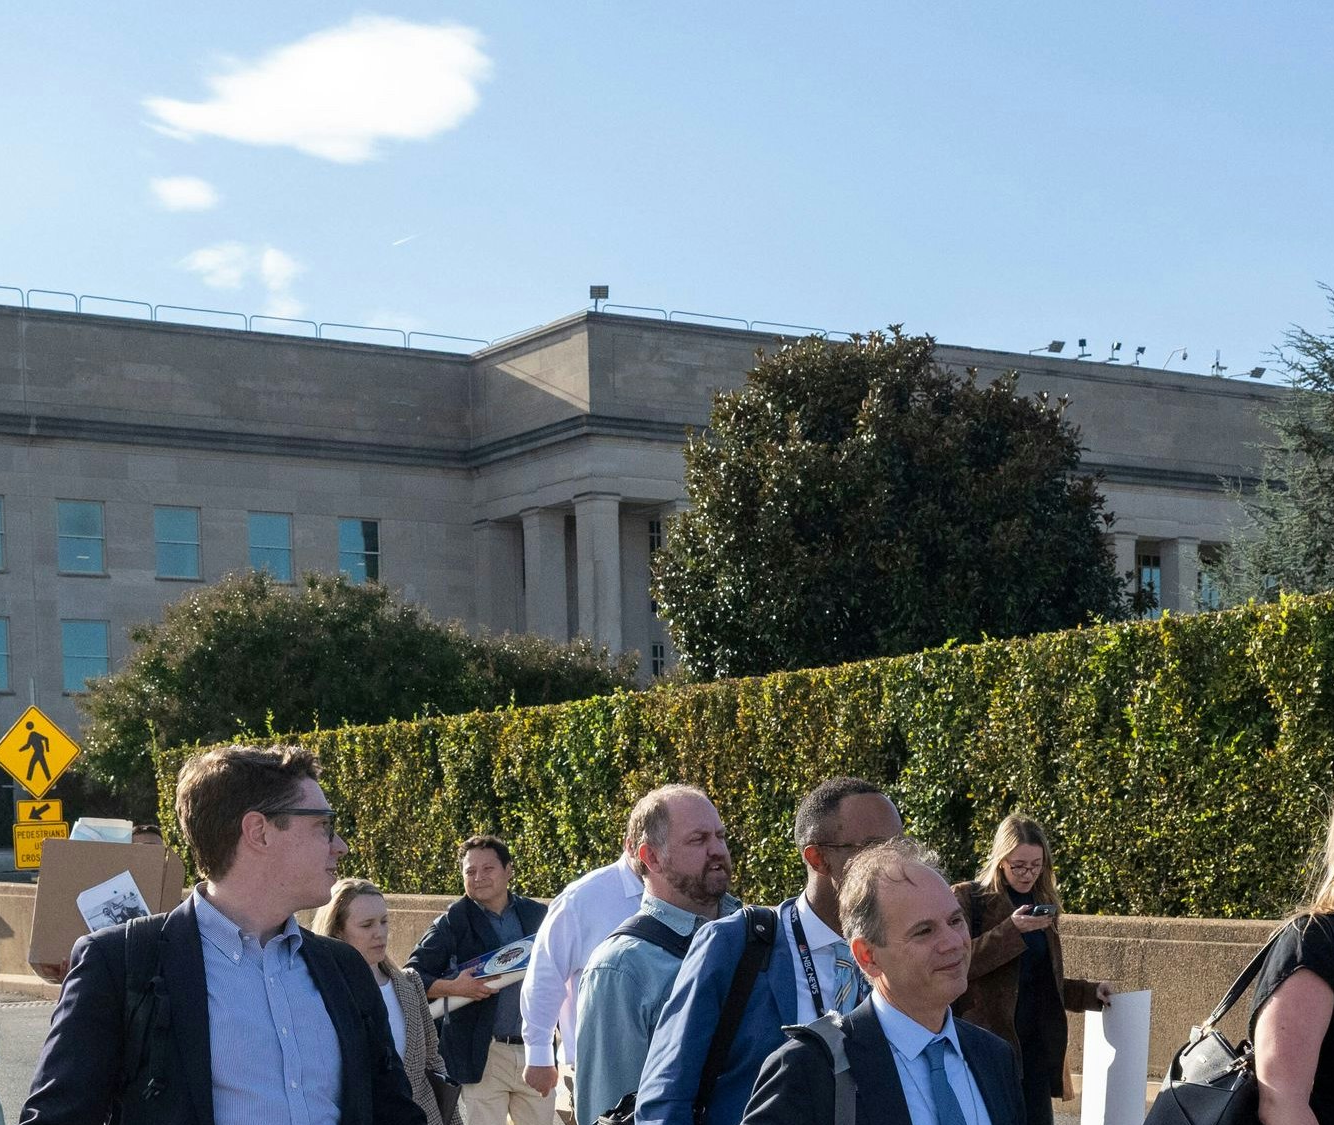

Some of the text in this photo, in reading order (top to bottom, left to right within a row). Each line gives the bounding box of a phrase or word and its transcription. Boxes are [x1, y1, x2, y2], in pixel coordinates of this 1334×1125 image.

[17, 830, 65, 839] PEDESTRIANS
[802, 955, 819, 995] NBC NEWS
